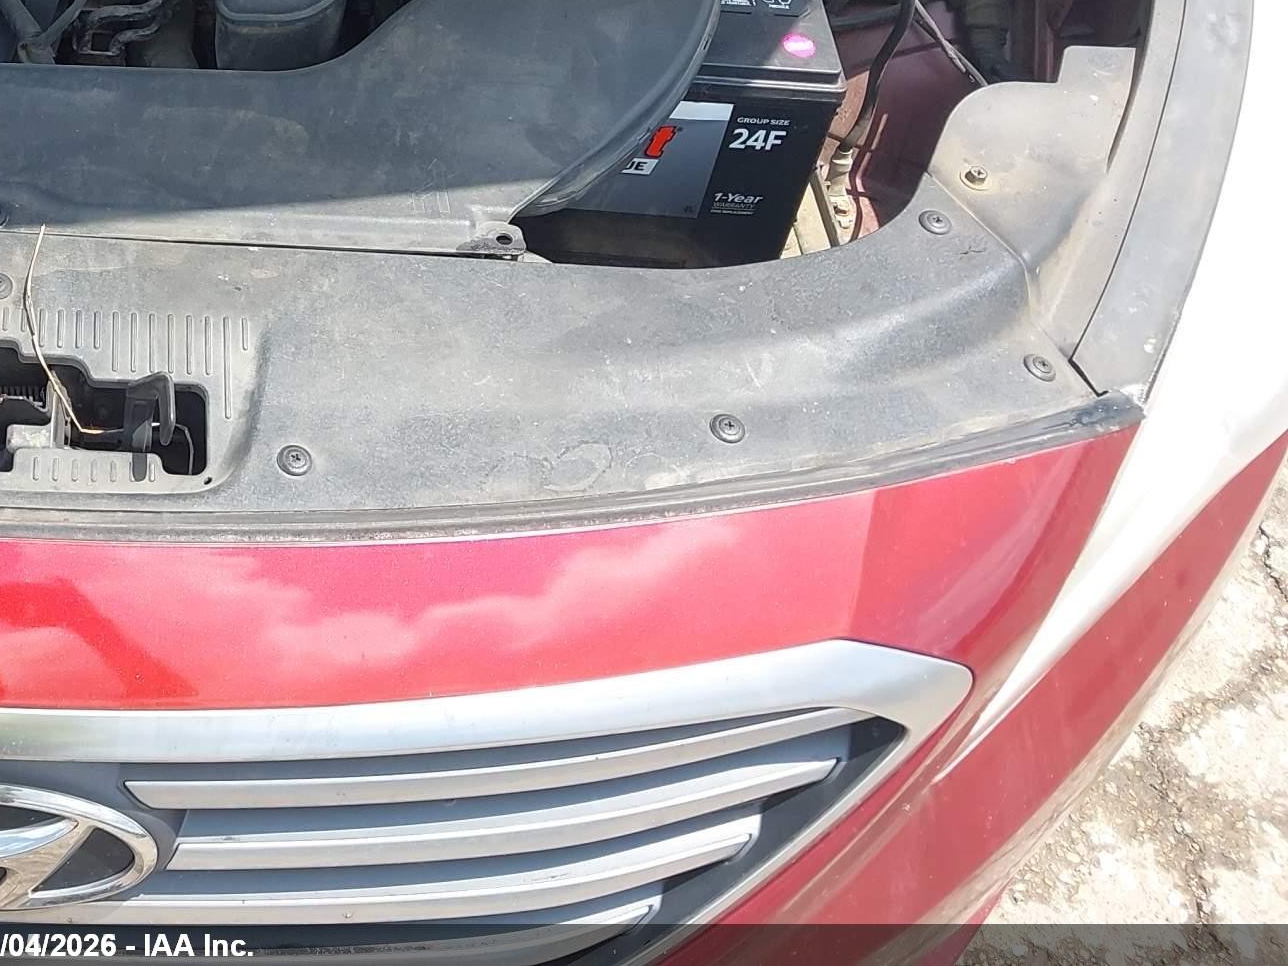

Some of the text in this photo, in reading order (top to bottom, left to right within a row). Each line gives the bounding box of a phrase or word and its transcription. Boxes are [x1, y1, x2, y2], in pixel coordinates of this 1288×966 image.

[736, 117, 770, 125] GROUP
[728, 128, 787, 150] 24F
[714, 192, 763, 203] 1-Year
